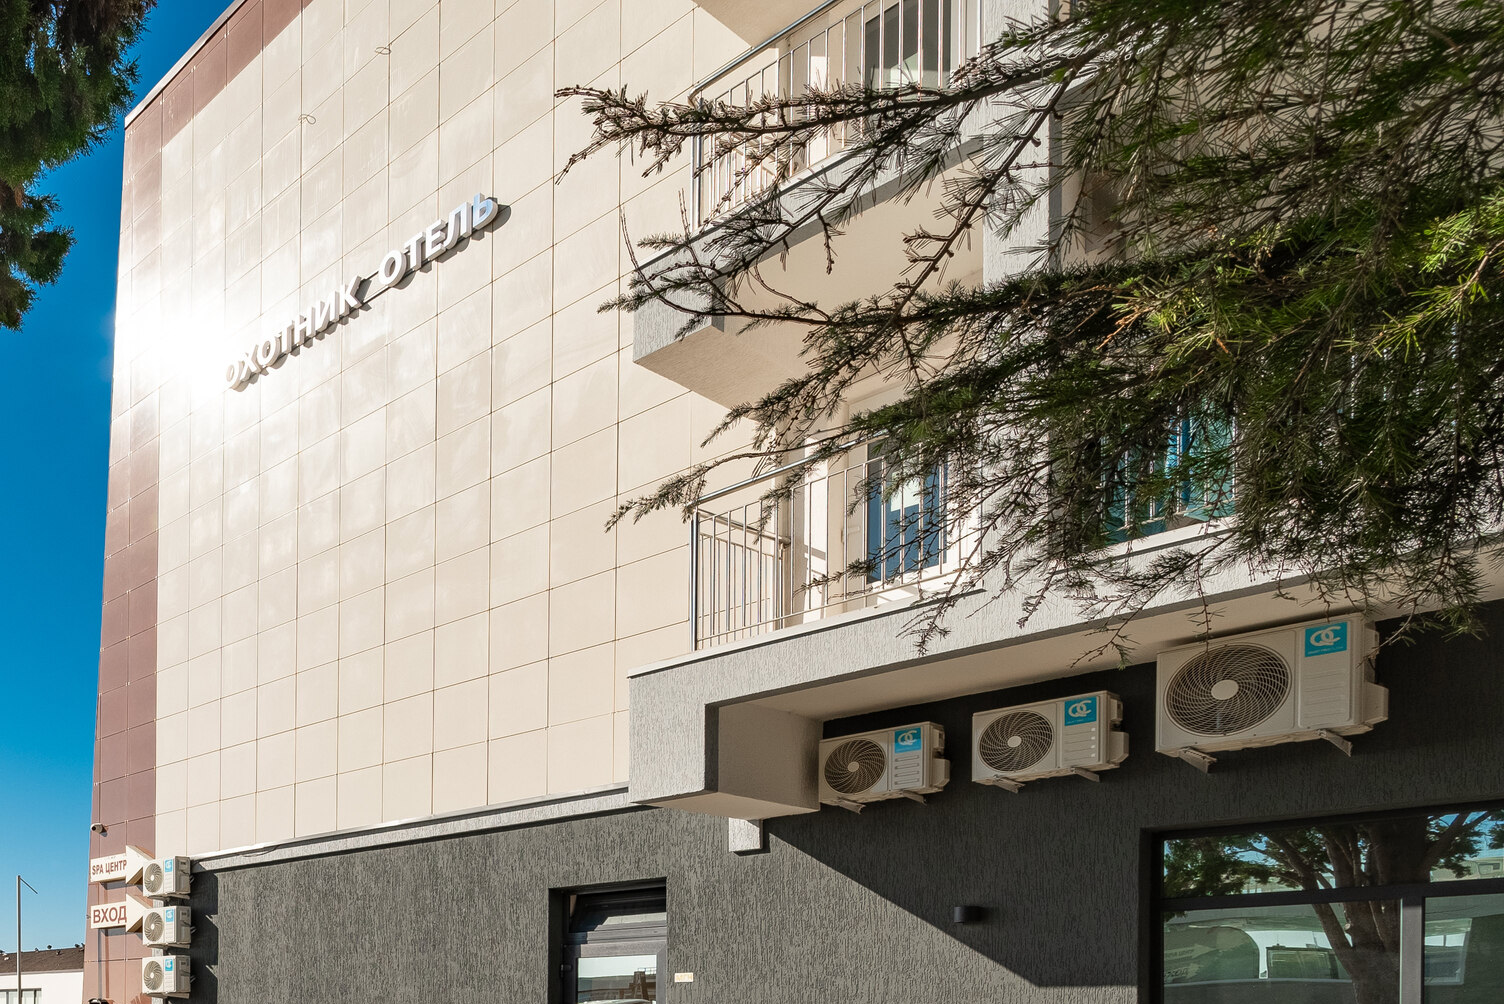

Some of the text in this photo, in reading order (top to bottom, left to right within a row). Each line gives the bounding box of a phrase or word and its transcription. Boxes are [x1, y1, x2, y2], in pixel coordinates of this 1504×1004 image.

[378, 192, 498, 288] ОТЕЛЬ
[91, 859, 128, 876] SPA ЦЕНТР
[93, 905, 127, 924] ВХОД
